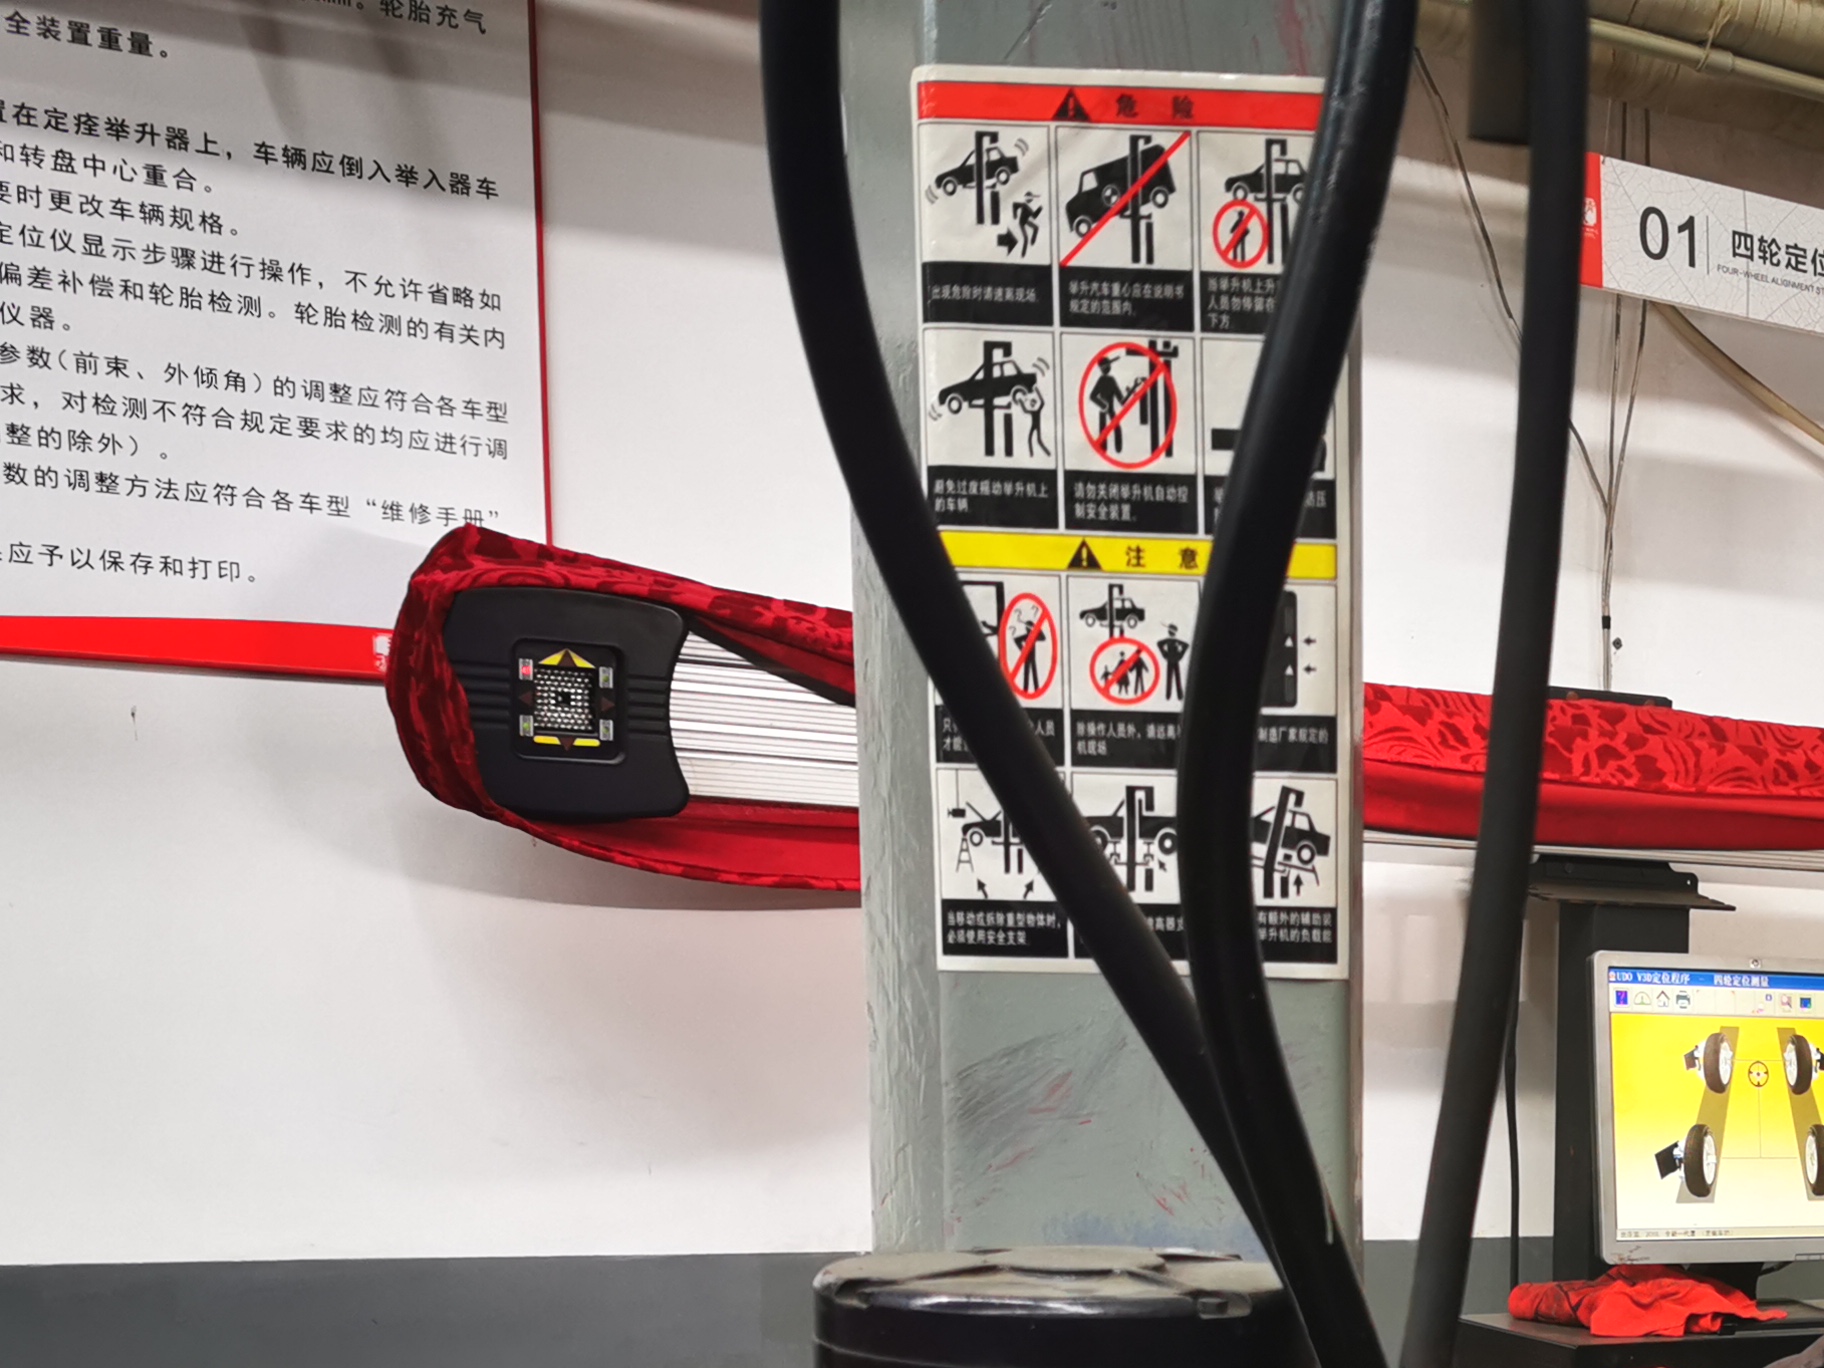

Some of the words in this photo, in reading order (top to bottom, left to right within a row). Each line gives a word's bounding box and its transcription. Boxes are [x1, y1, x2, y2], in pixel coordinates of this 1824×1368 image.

[5, 10, 168, 58] 全装置重量。
[1115, 93, 1195, 120] 危险
[0, 99, 499, 200] 在定痊举升器上，车辆应倒入举入器车
[1638, 206, 1697, 269] 01
[1771, 276, 1815, 294] ALIGNMENT
[8, 541, 256, 584] 应予以保存和打印。
[1125, 545, 1200, 570] 注意
